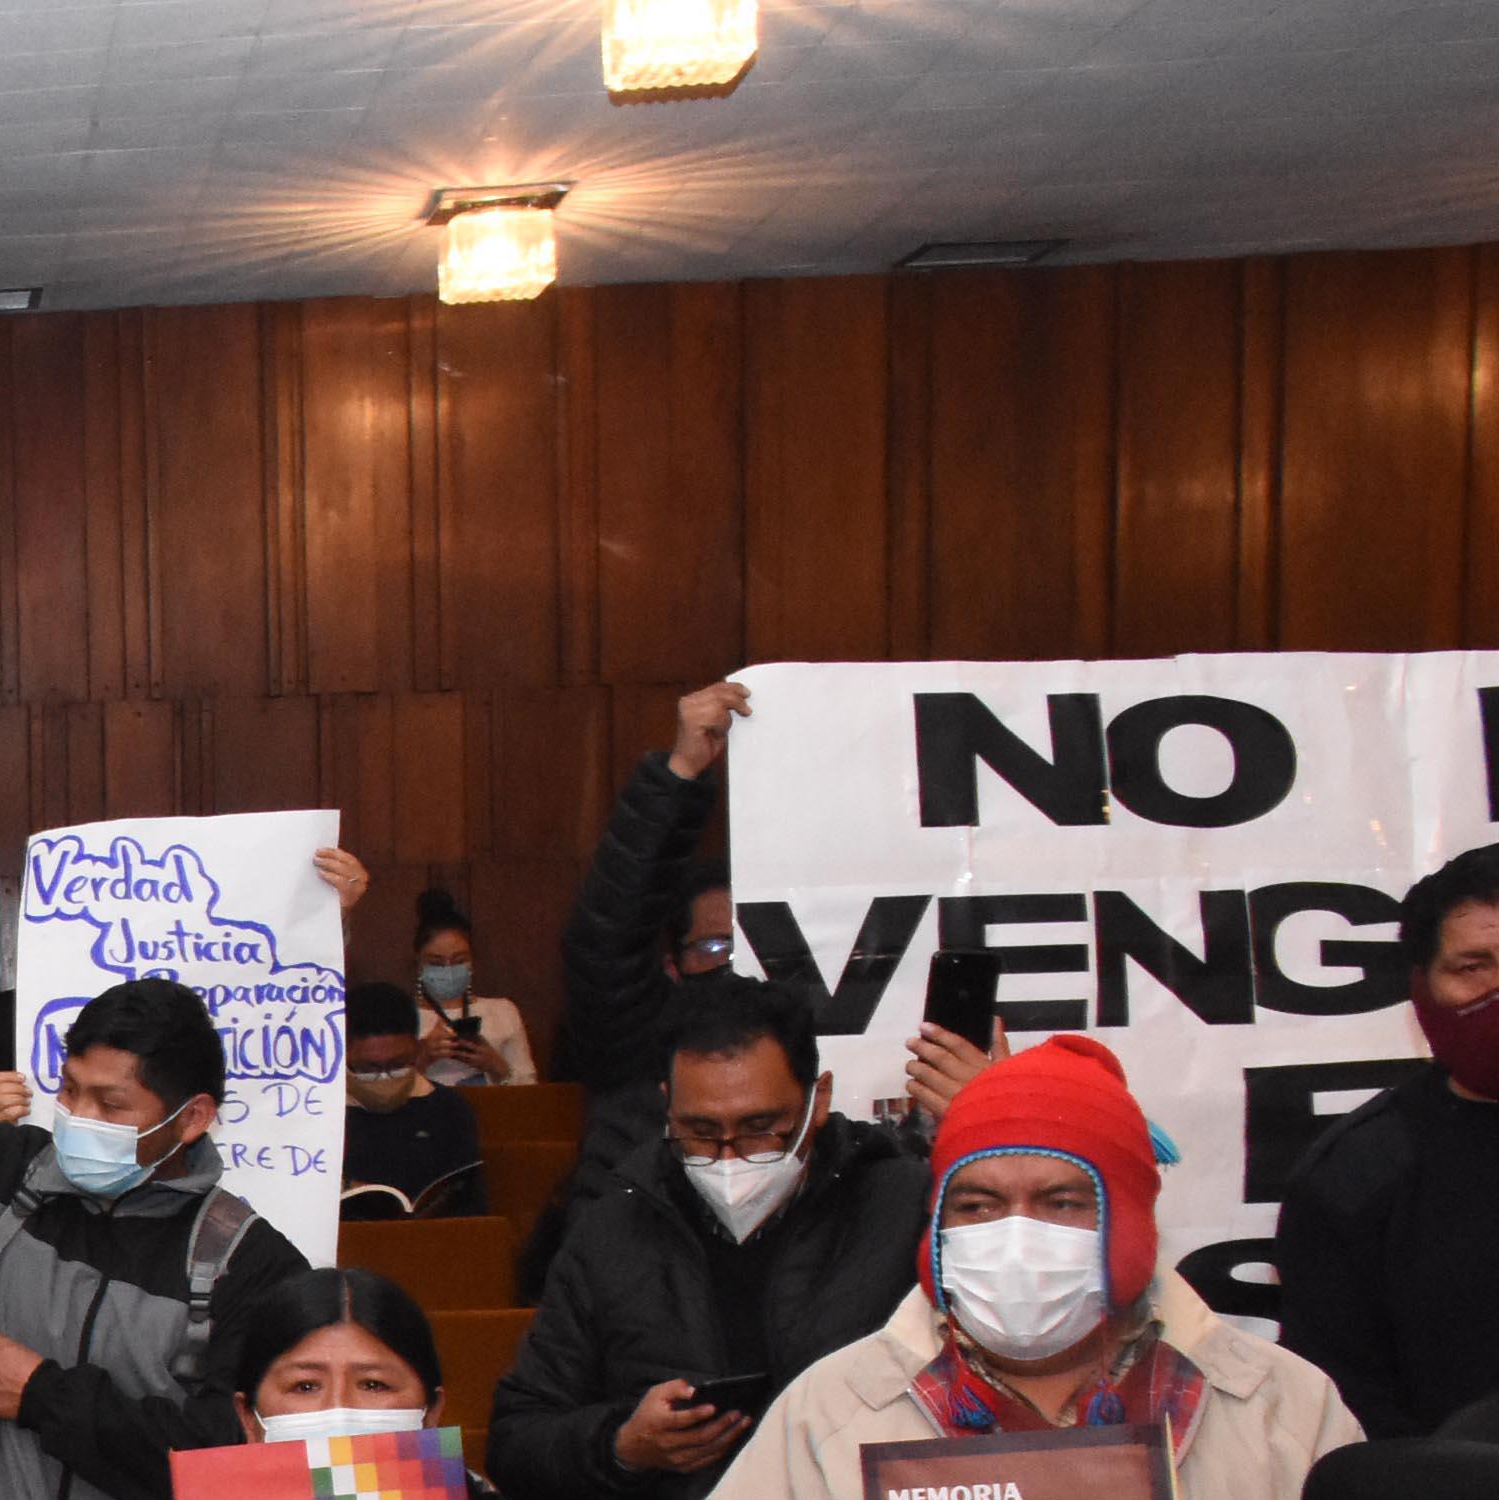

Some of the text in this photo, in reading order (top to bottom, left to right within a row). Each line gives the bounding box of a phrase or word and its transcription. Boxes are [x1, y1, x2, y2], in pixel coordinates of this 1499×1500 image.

[913, 692, 1297, 828] NO
[33, 845, 193, 904] Verdad
[108, 917, 265, 964] Justicia
[142, 968, 346, 1017] paración
[261, 1082, 323, 1118] DE
[283, 1145, 327, 1176] DE
